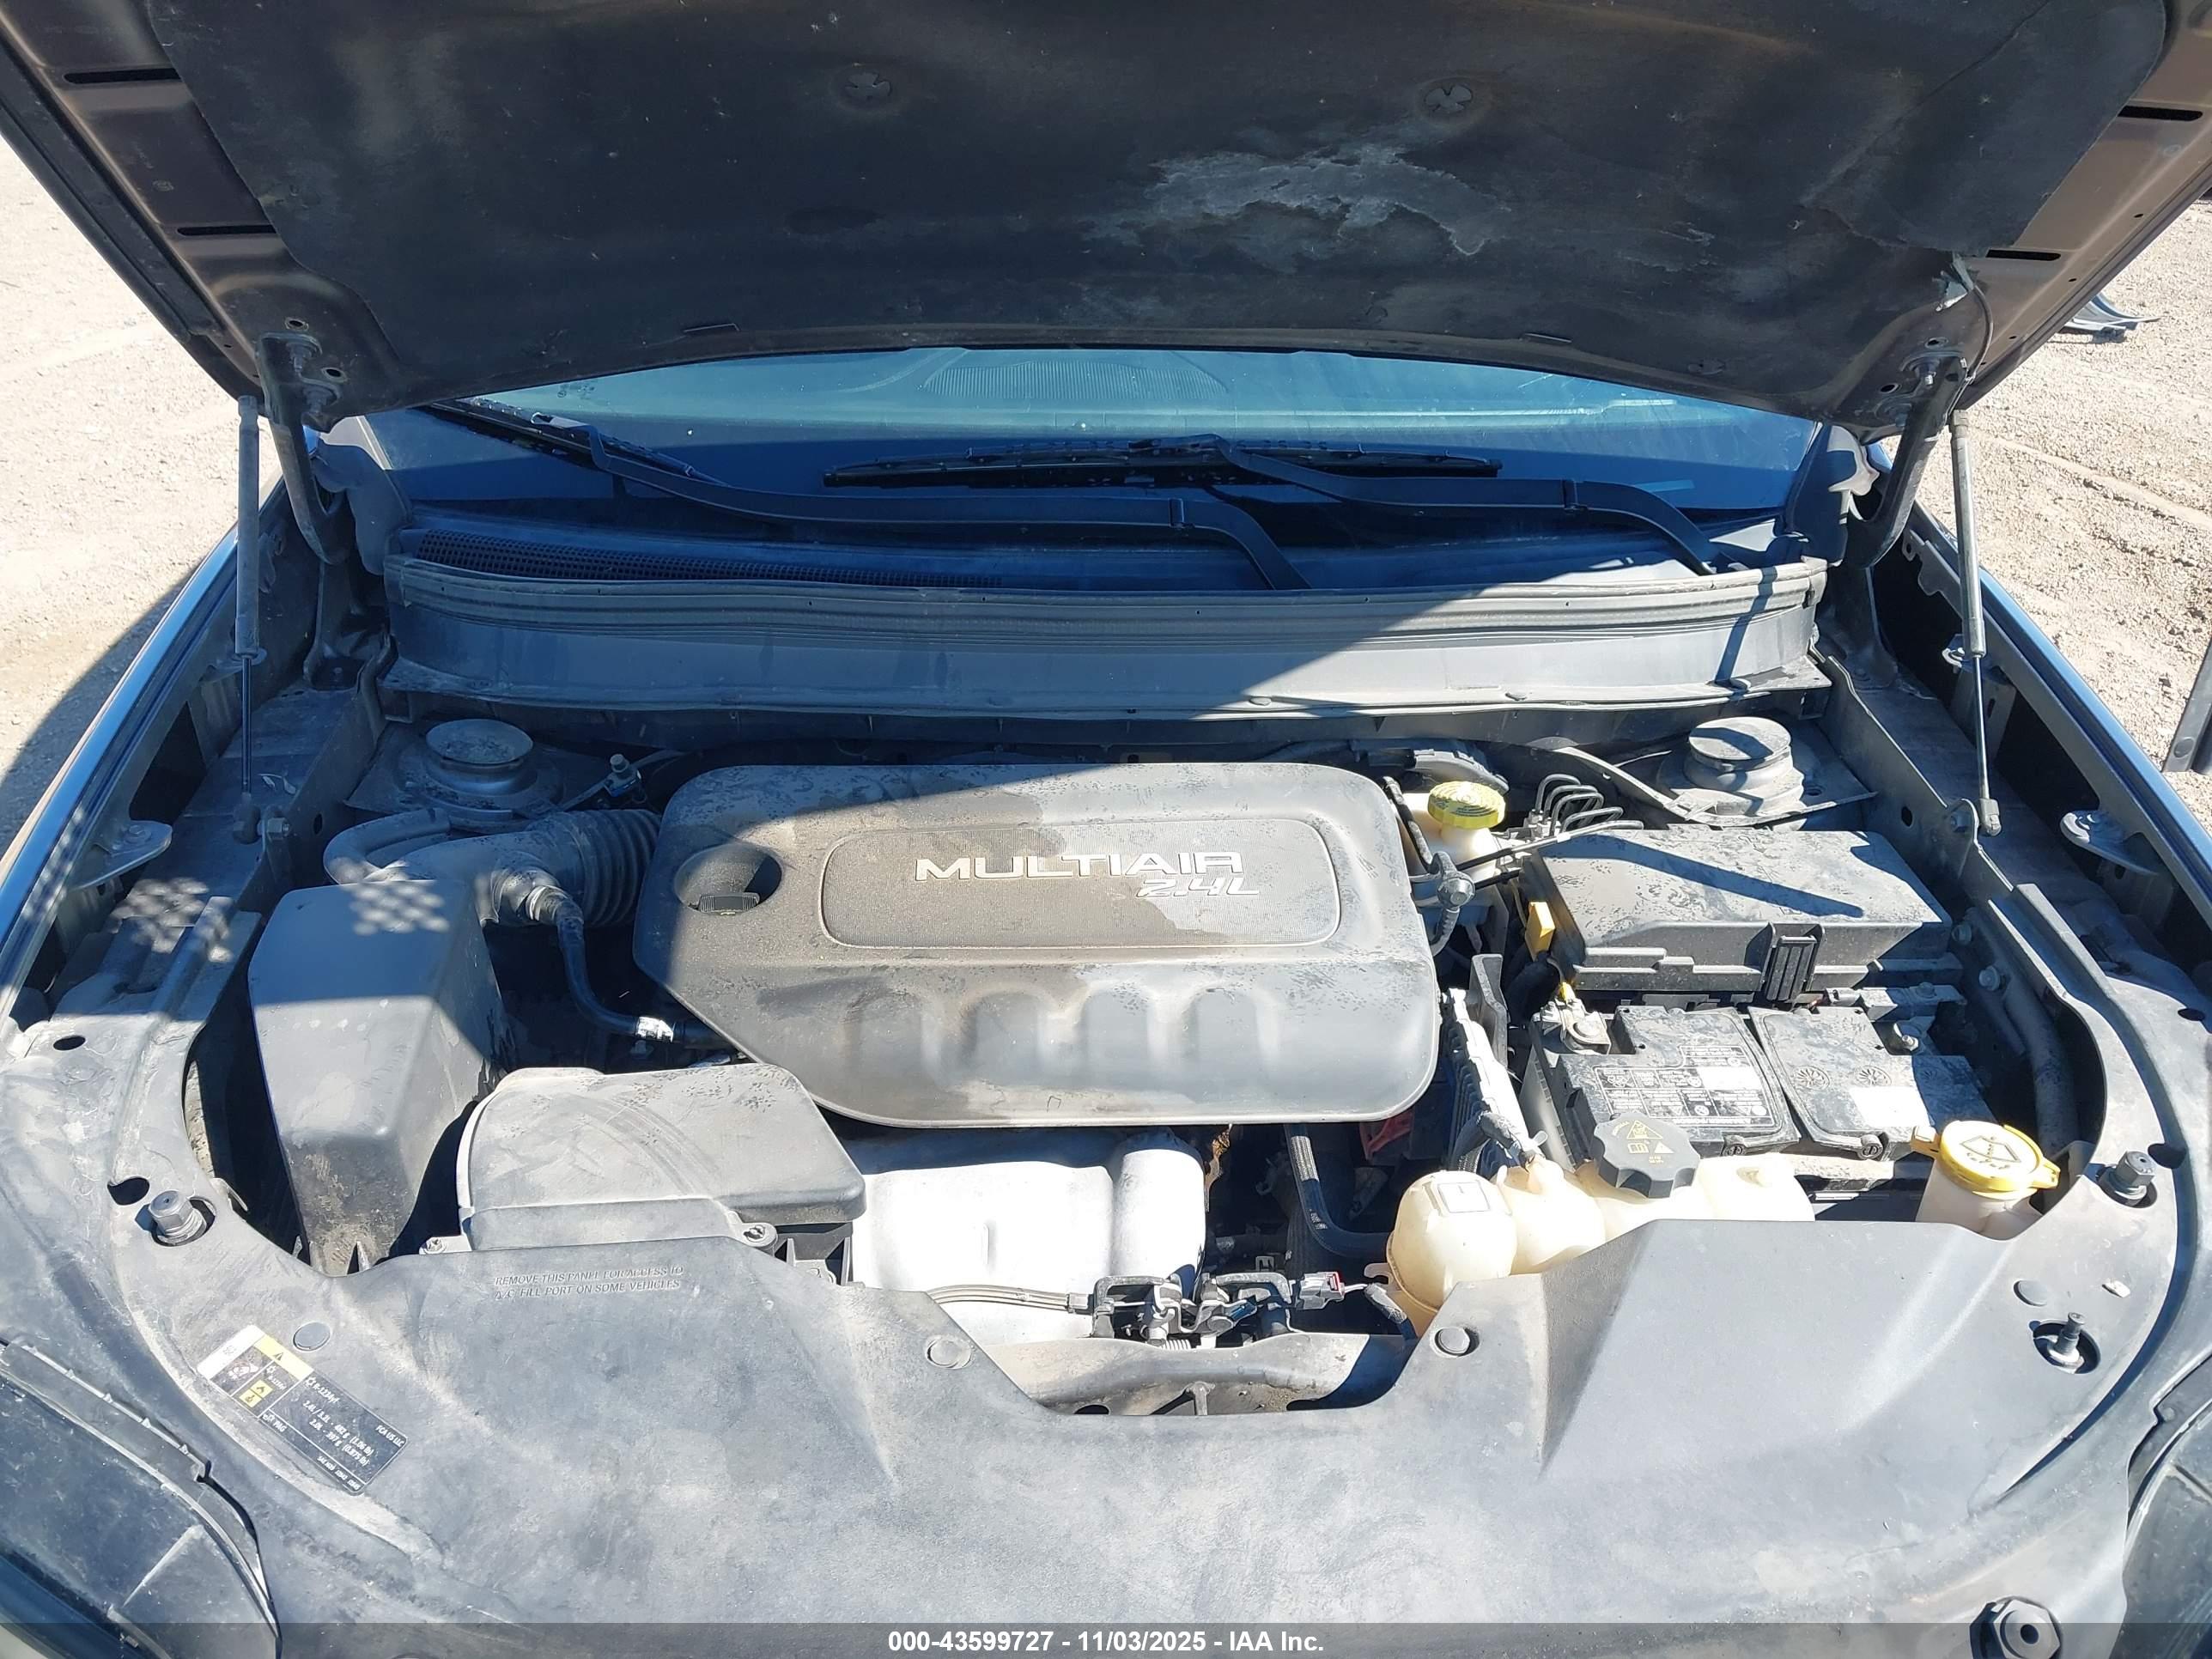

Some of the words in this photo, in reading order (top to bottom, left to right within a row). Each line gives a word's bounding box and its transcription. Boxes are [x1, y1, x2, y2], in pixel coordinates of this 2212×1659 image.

[915, 851, 1244, 881] MULTIAIR
[1136, 877, 1260, 897] 2.4L
[495, 1275, 538, 1285] REMOVE
[542, 1273, 565, 1283] THIS
[568, 1271, 599, 1281] PANEL
[603, 1269, 624, 1279] FOR
[624, 1267, 667, 1278] ACCESS
[671, 1266, 684, 1276] TO
[495, 1290, 515, 1299] A/C
[520, 1288, 540, 1297] FILL
[544, 1285, 574, 1296] PORT
[576, 1285, 592, 1294] ON
[595, 1283, 625, 1292] SOME
[630, 1279, 680, 1291] VEHICLES
[313, 1383, 340, 1403] R-1234yf
[273, 1421, 287, 1432] PAG
[375, 1425, 388, 1436] FCA
[386, 1432, 395, 1441] US
[392, 1437, 404, 1447] LLC
[325, 1431, 337, 1443] 397
[342, 1444, 361, 1460] (0.875
[349, 1436, 367, 1450] (1.06
